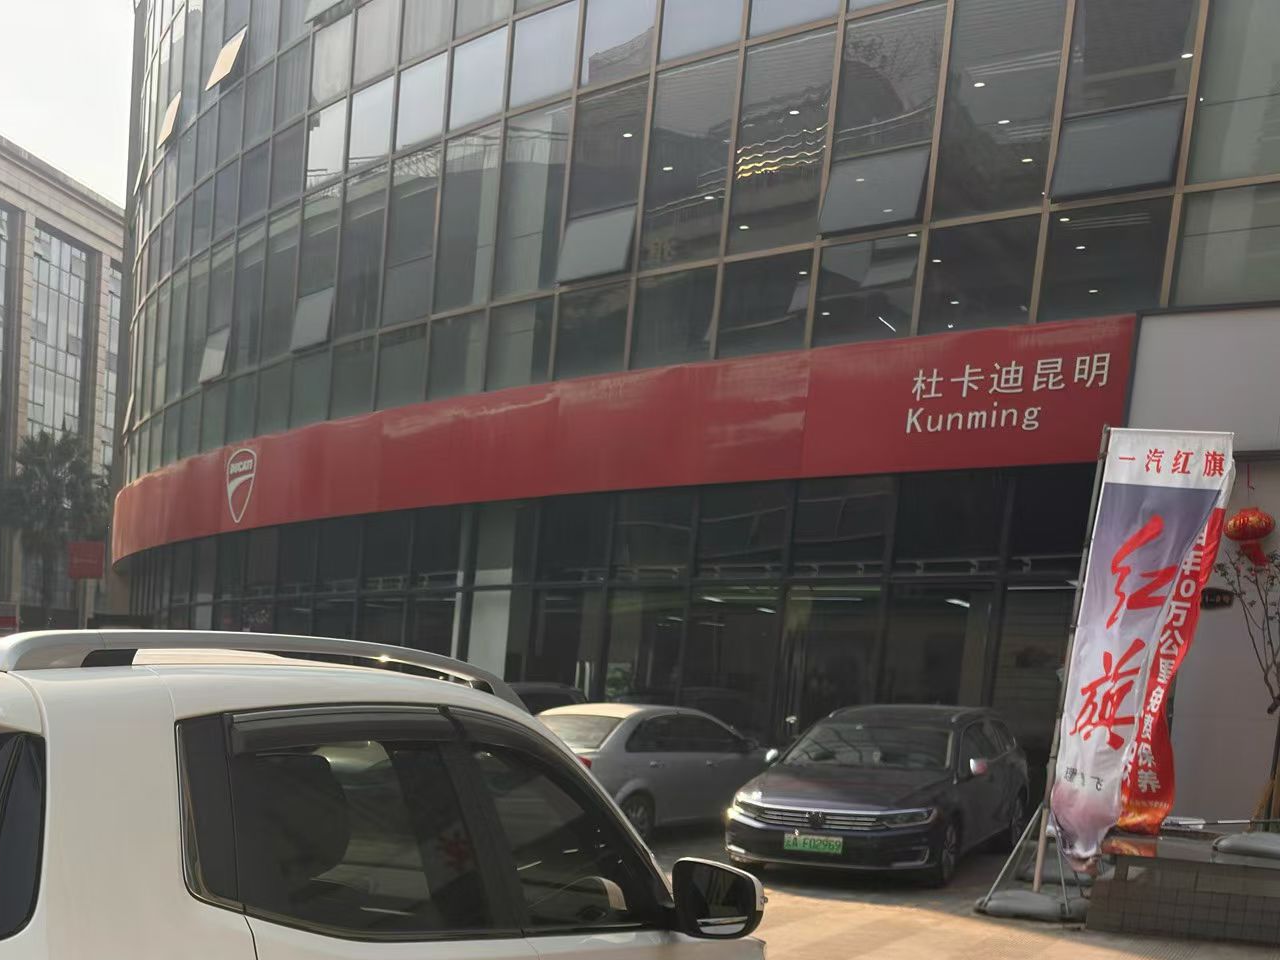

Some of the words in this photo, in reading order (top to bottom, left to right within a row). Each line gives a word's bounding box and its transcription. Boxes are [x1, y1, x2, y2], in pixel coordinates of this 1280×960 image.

[912, 352, 1111, 401] 杜卡迪昆明
[906, 401, 1041, 433] Kunming
[1119, 448, 1225, 477] 一汽红旗
